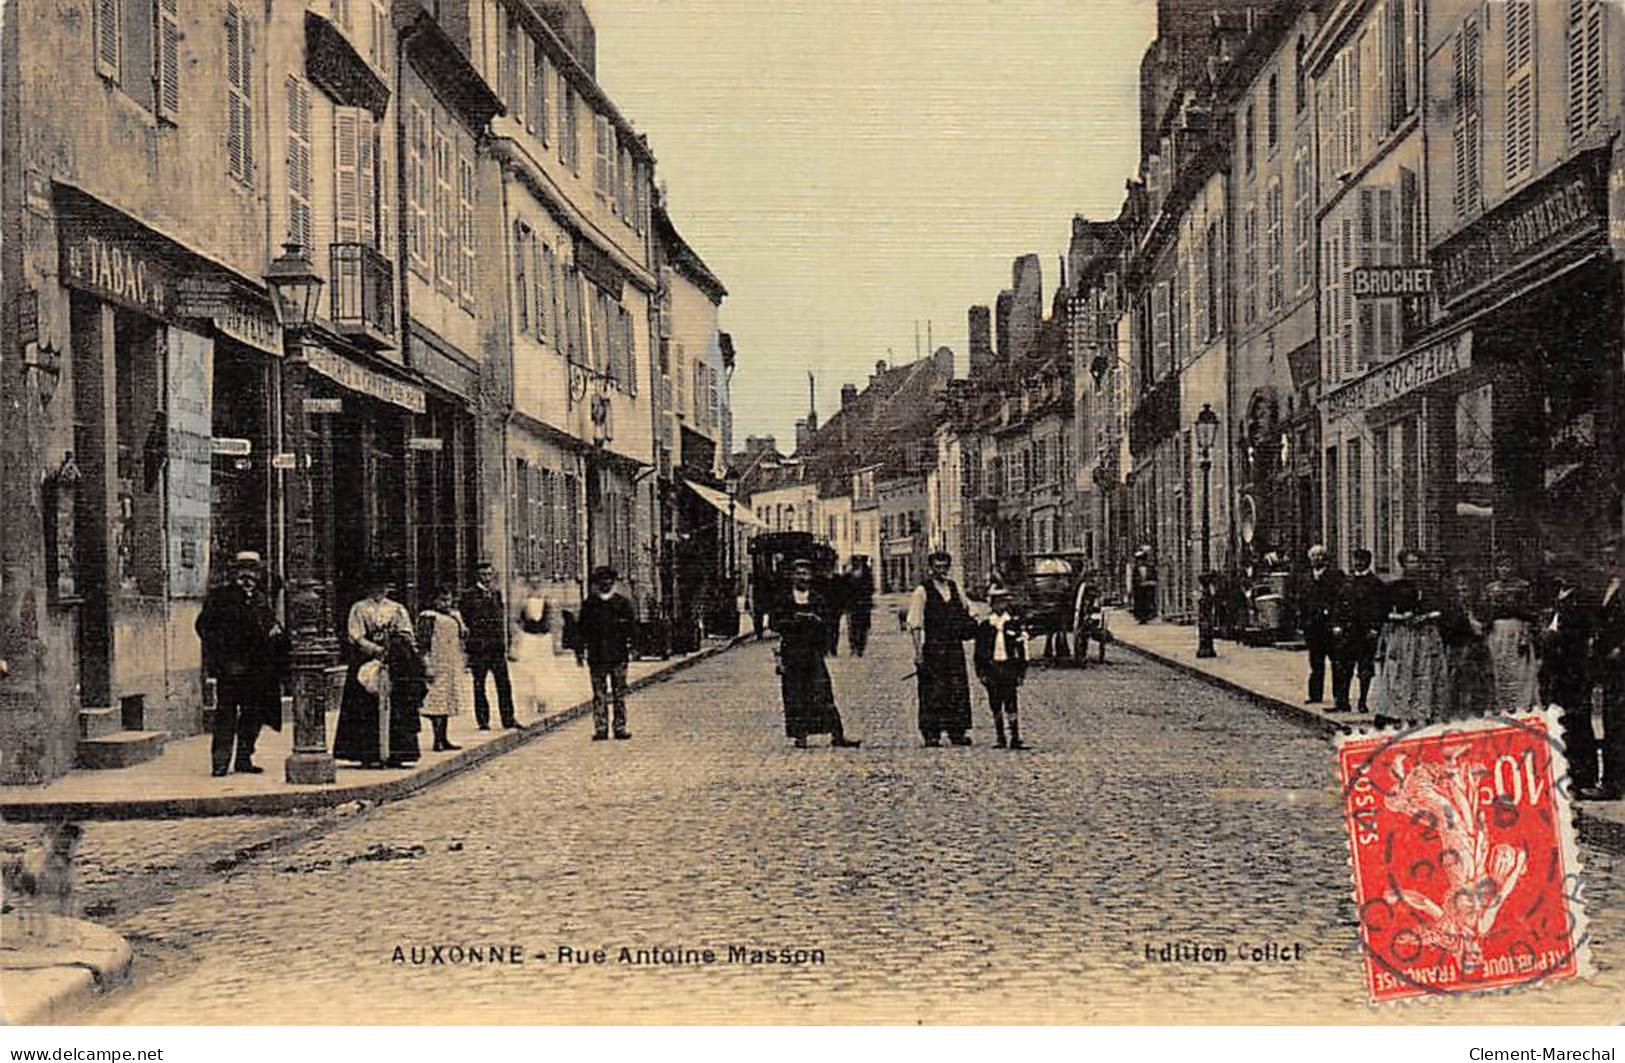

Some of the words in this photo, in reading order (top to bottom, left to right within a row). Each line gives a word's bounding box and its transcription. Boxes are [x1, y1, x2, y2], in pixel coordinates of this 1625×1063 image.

[87, 235, 148, 303] TABAC
[1356, 269, 1433, 294] BROCHET
[1376, 962, 1456, 991] FRANÇISE
